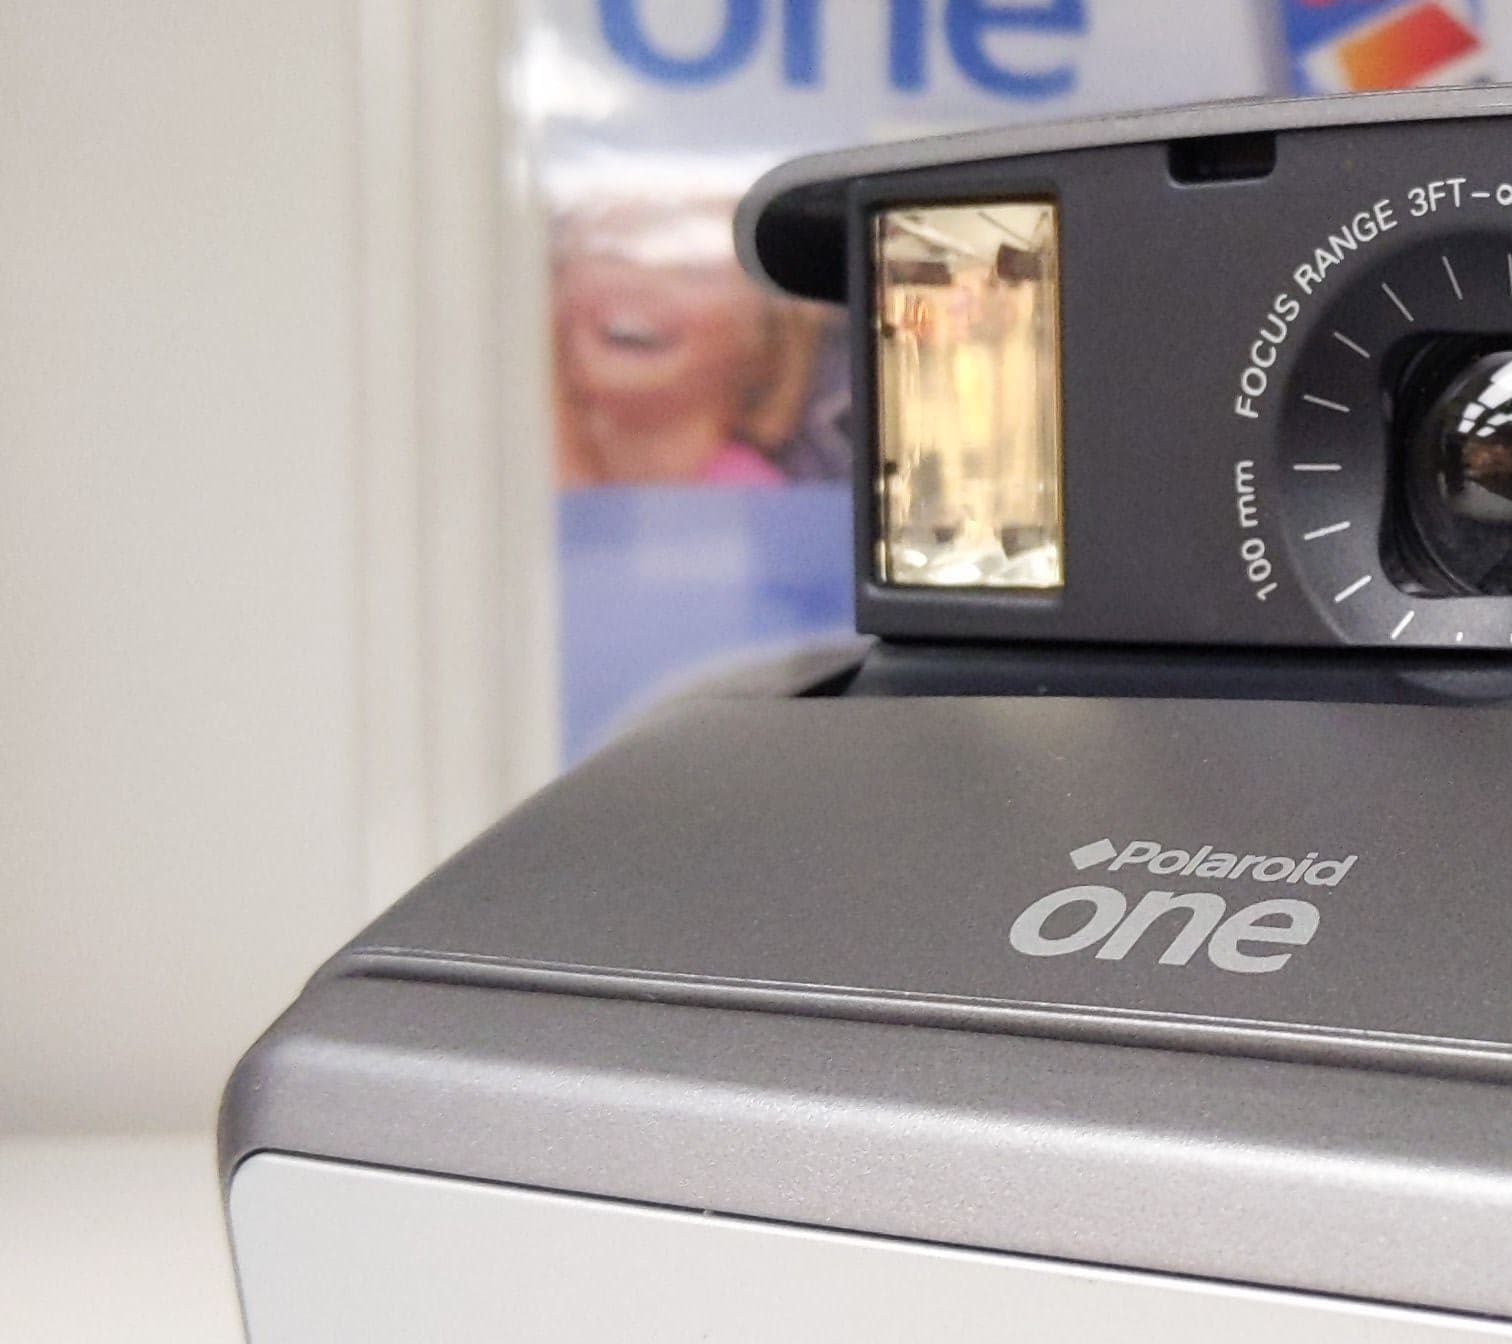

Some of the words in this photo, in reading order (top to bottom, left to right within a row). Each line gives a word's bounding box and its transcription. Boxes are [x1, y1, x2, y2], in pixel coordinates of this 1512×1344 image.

[1235, 293, 1301, 419] FOCUS
[1293, 199, 1398, 294] RANGE
[1235, 459, 1259, 529] mm
[1241, 538, 1278, 601] 100
[1107, 840, 1358, 887] Polaroid
[1009, 885, 1320, 974] one
